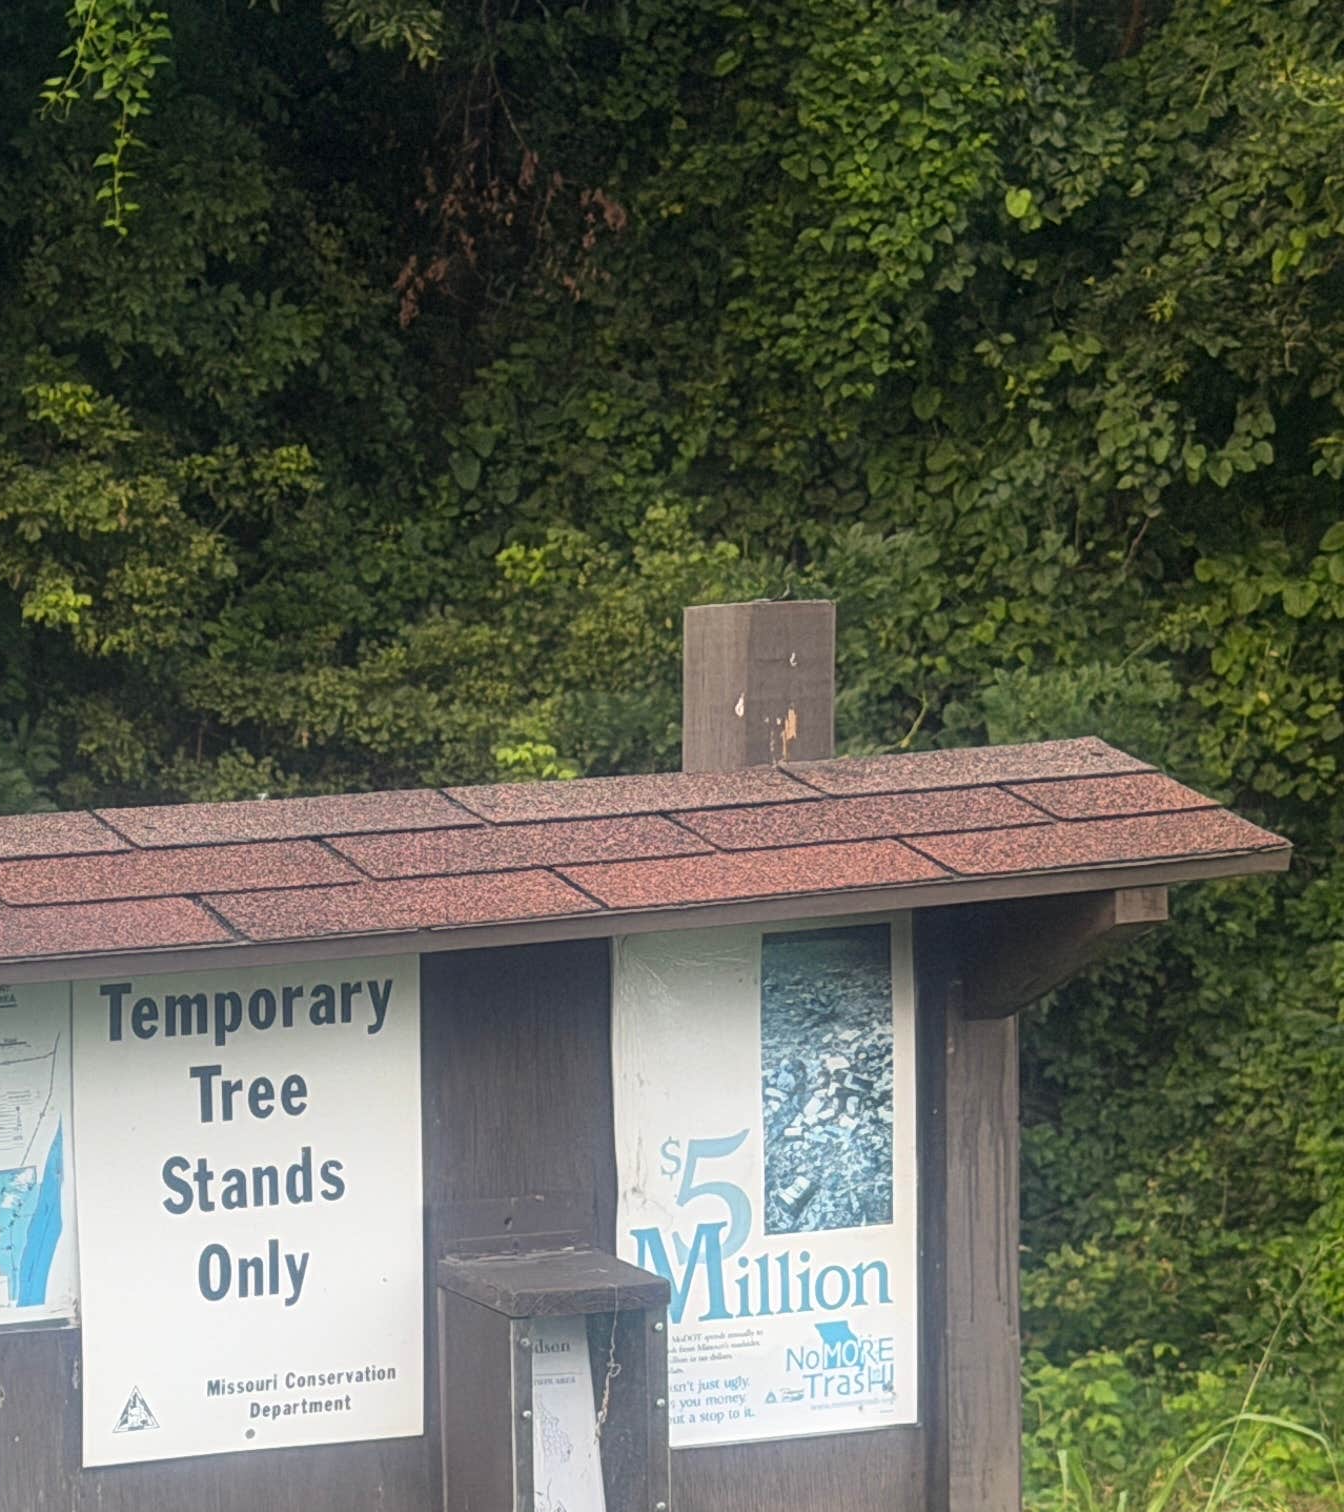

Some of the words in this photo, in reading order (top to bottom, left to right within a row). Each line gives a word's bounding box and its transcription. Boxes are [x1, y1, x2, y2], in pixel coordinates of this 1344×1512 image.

[99, 979, 393, 1046] Temporary
[188, 1063, 308, 1124] Tree
[161, 1145, 346, 1215] Stands
[660, 1128, 752, 1266] $5
[198, 1238, 310, 1307] Only
[630, 1222, 893, 1324] Million
[206, 1373, 278, 1397] Missouri
[285, 1364, 397, 1390] Conservation
[249, 1394, 352, 1421] Department
[680, 1395, 700, 1409] you
[698, 1377, 720, 1393] just
[689, 1413, 695, 1423] a
[700, 1410, 724, 1423] stop
[729, 1407, 740, 1419] to
[744, 1406, 755, 1417] it.
